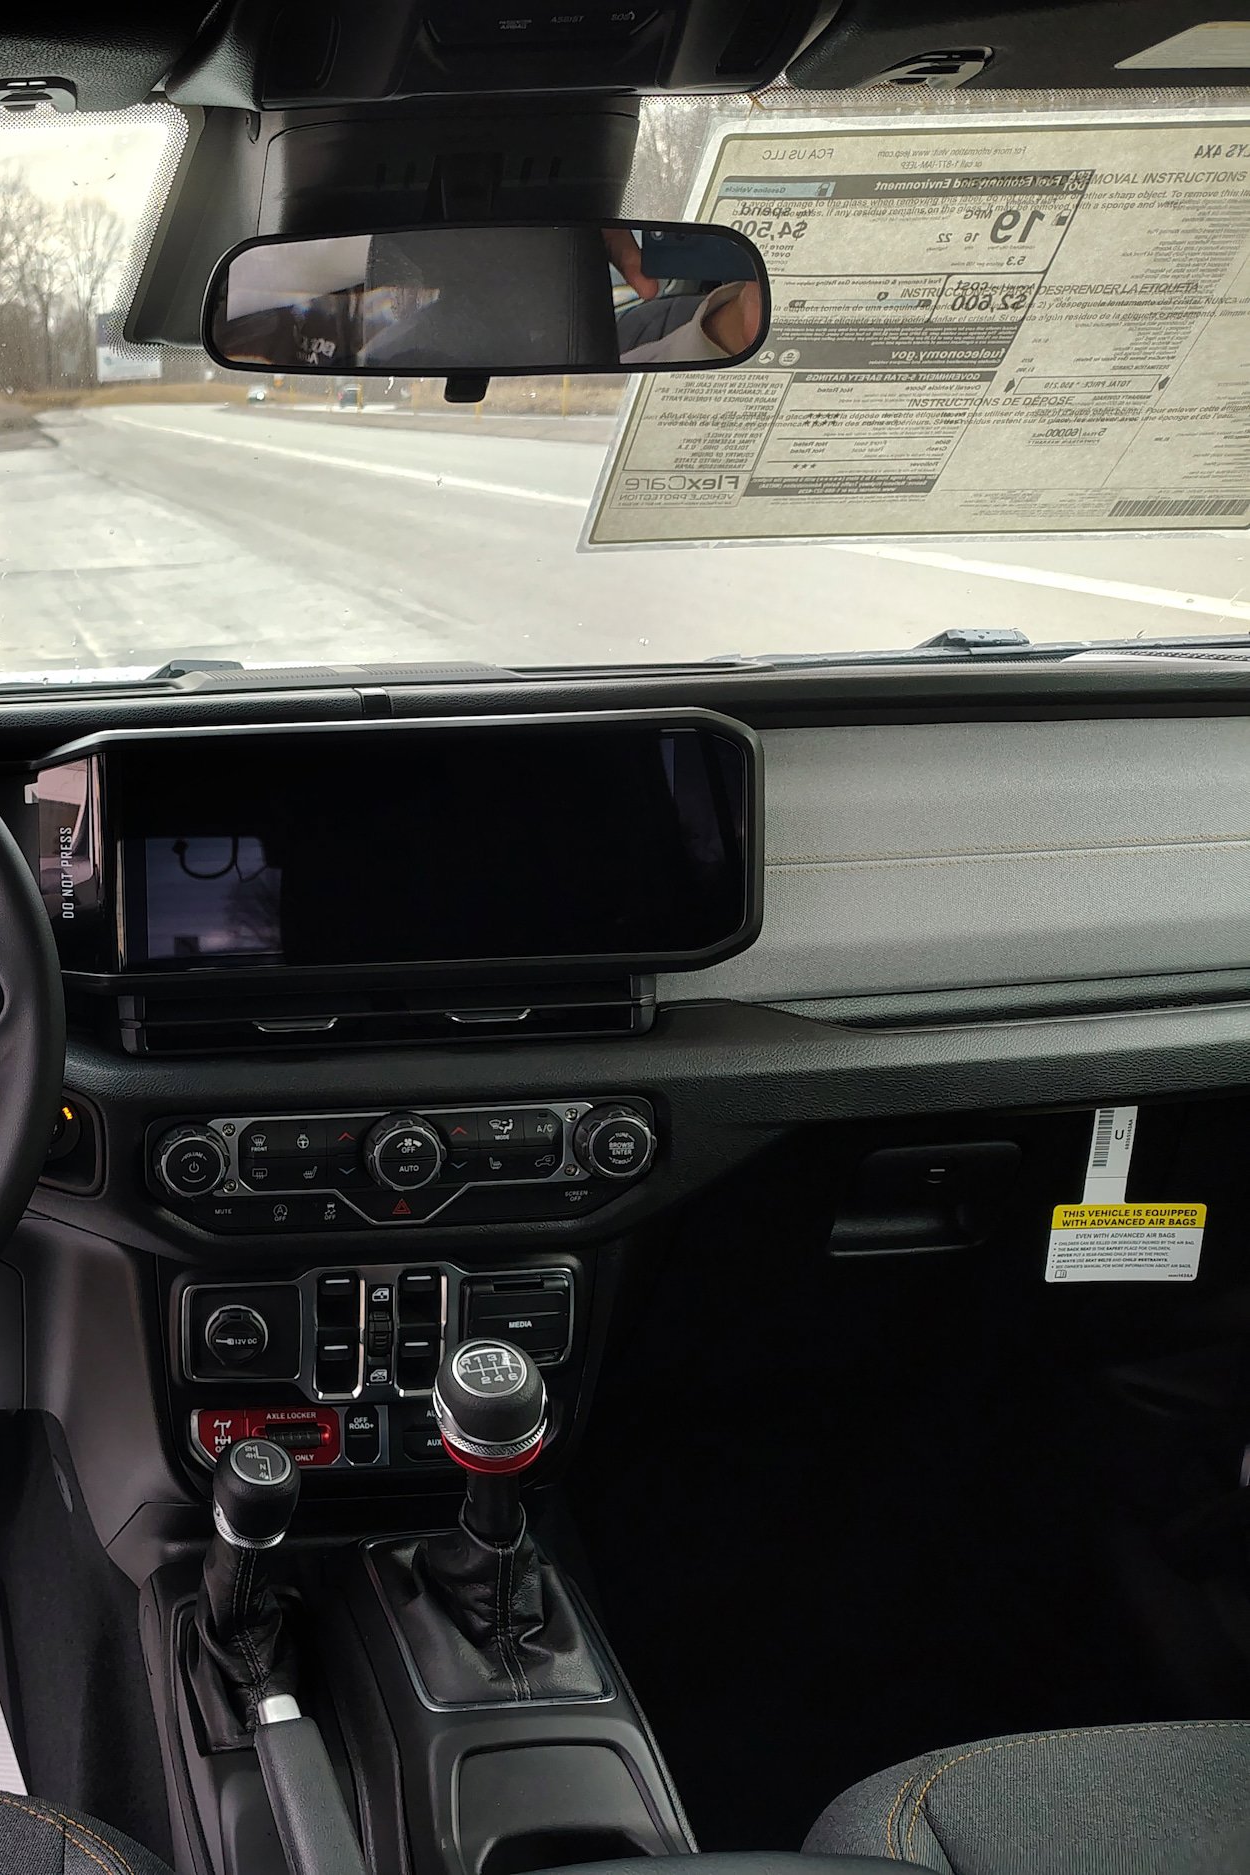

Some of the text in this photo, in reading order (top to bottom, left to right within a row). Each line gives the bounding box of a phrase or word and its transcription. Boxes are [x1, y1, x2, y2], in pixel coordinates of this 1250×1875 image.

[1142, 171, 1248, 184] INSTRUCTIONS
[1109, 190, 1135, 201] sharp
[1171, 190, 1182, 198] To
[1184, 190, 1218, 198] remove
[1100, 202, 1136, 211] sponge
[1137, 200, 1156, 209] and
[1038, 284, 1119, 296] DESPRENDER
[1121, 284, 1138, 294] LA
[1138, 282, 1200, 294] ETIQUETA
[908, 398, 1001, 408] INSTRUCTIONS
[1002, 398, 1021, 407] DE
[59, 827, 75, 919] DO NOT PRESS
[536, 1124, 553, 1134] A/C
[609, 1141, 635, 1149] BROWSE
[398, 1165, 420, 1173] AUTO
[1063, 1209, 1198, 1218] THIS VEHICLE IS EQUIPPED
[1062, 1218, 1087, 1227] WITH
[1149, 1218, 1166, 1226] AIR
[1168, 1218, 1197, 1226] BAGS
[508, 1320, 533, 1329] MEDIA
[234, 1338, 247, 1346] 12V
[473, 1355, 482, 1363] 1
[486, 1353, 498, 1362] 3
[480, 1376, 492, 1385] 2
[493, 1374, 505, 1382] 4
[507, 1372, 519, 1381] 6
[265, 1411, 317, 1421] AXLE LOCKER
[426, 1439, 442, 1447] AUX
[294, 1454, 315, 1462] ONLY
